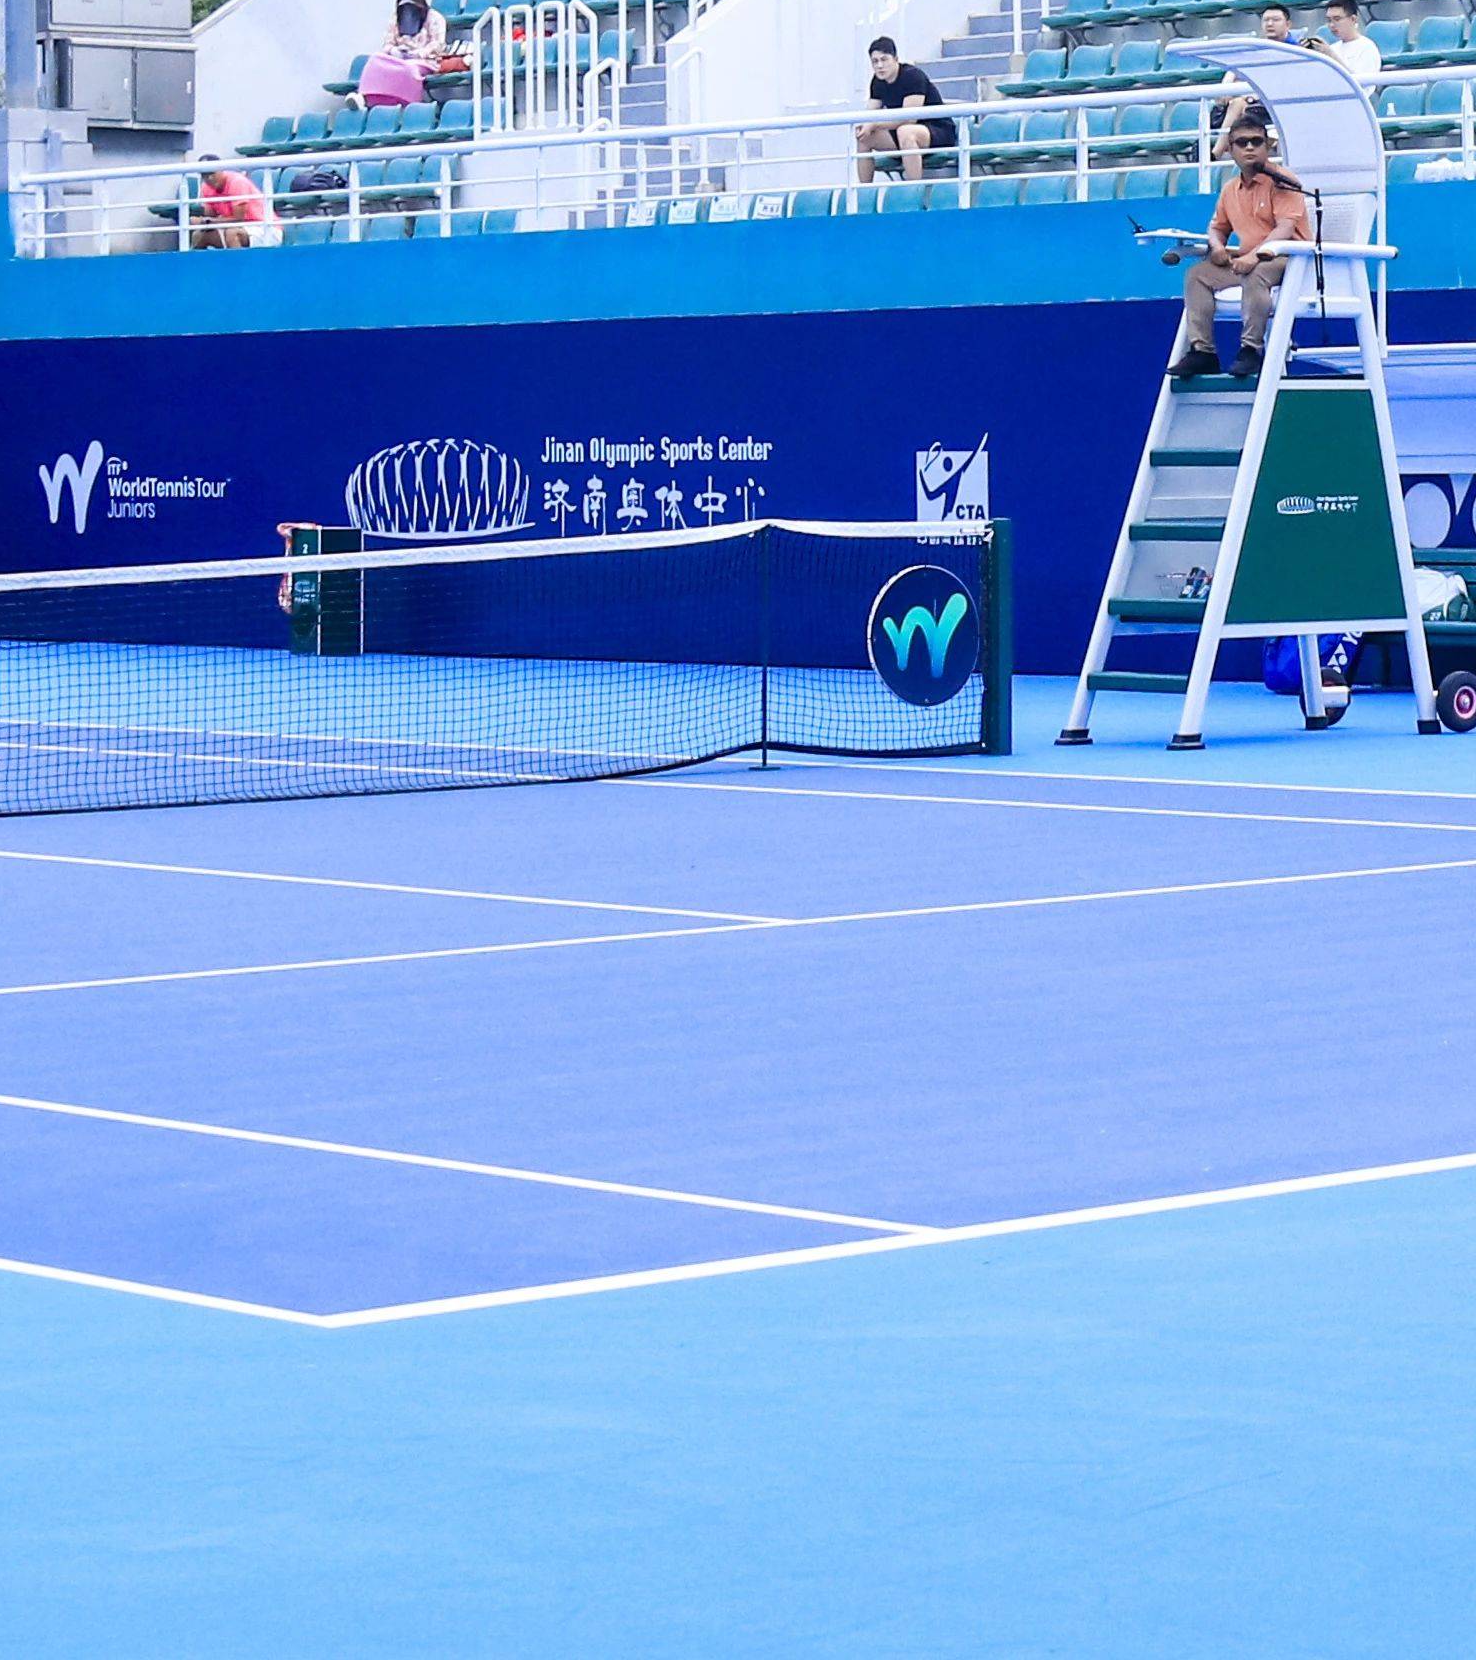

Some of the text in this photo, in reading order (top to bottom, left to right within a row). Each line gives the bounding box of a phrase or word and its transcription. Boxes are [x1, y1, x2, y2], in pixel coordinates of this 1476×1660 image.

[540, 434, 774, 469] Jinan Olympic Sports Center
[107, 498, 156, 519] Juniors
[543, 474, 767, 539] 济南奥体中心
[956, 505, 986, 520] CTA
